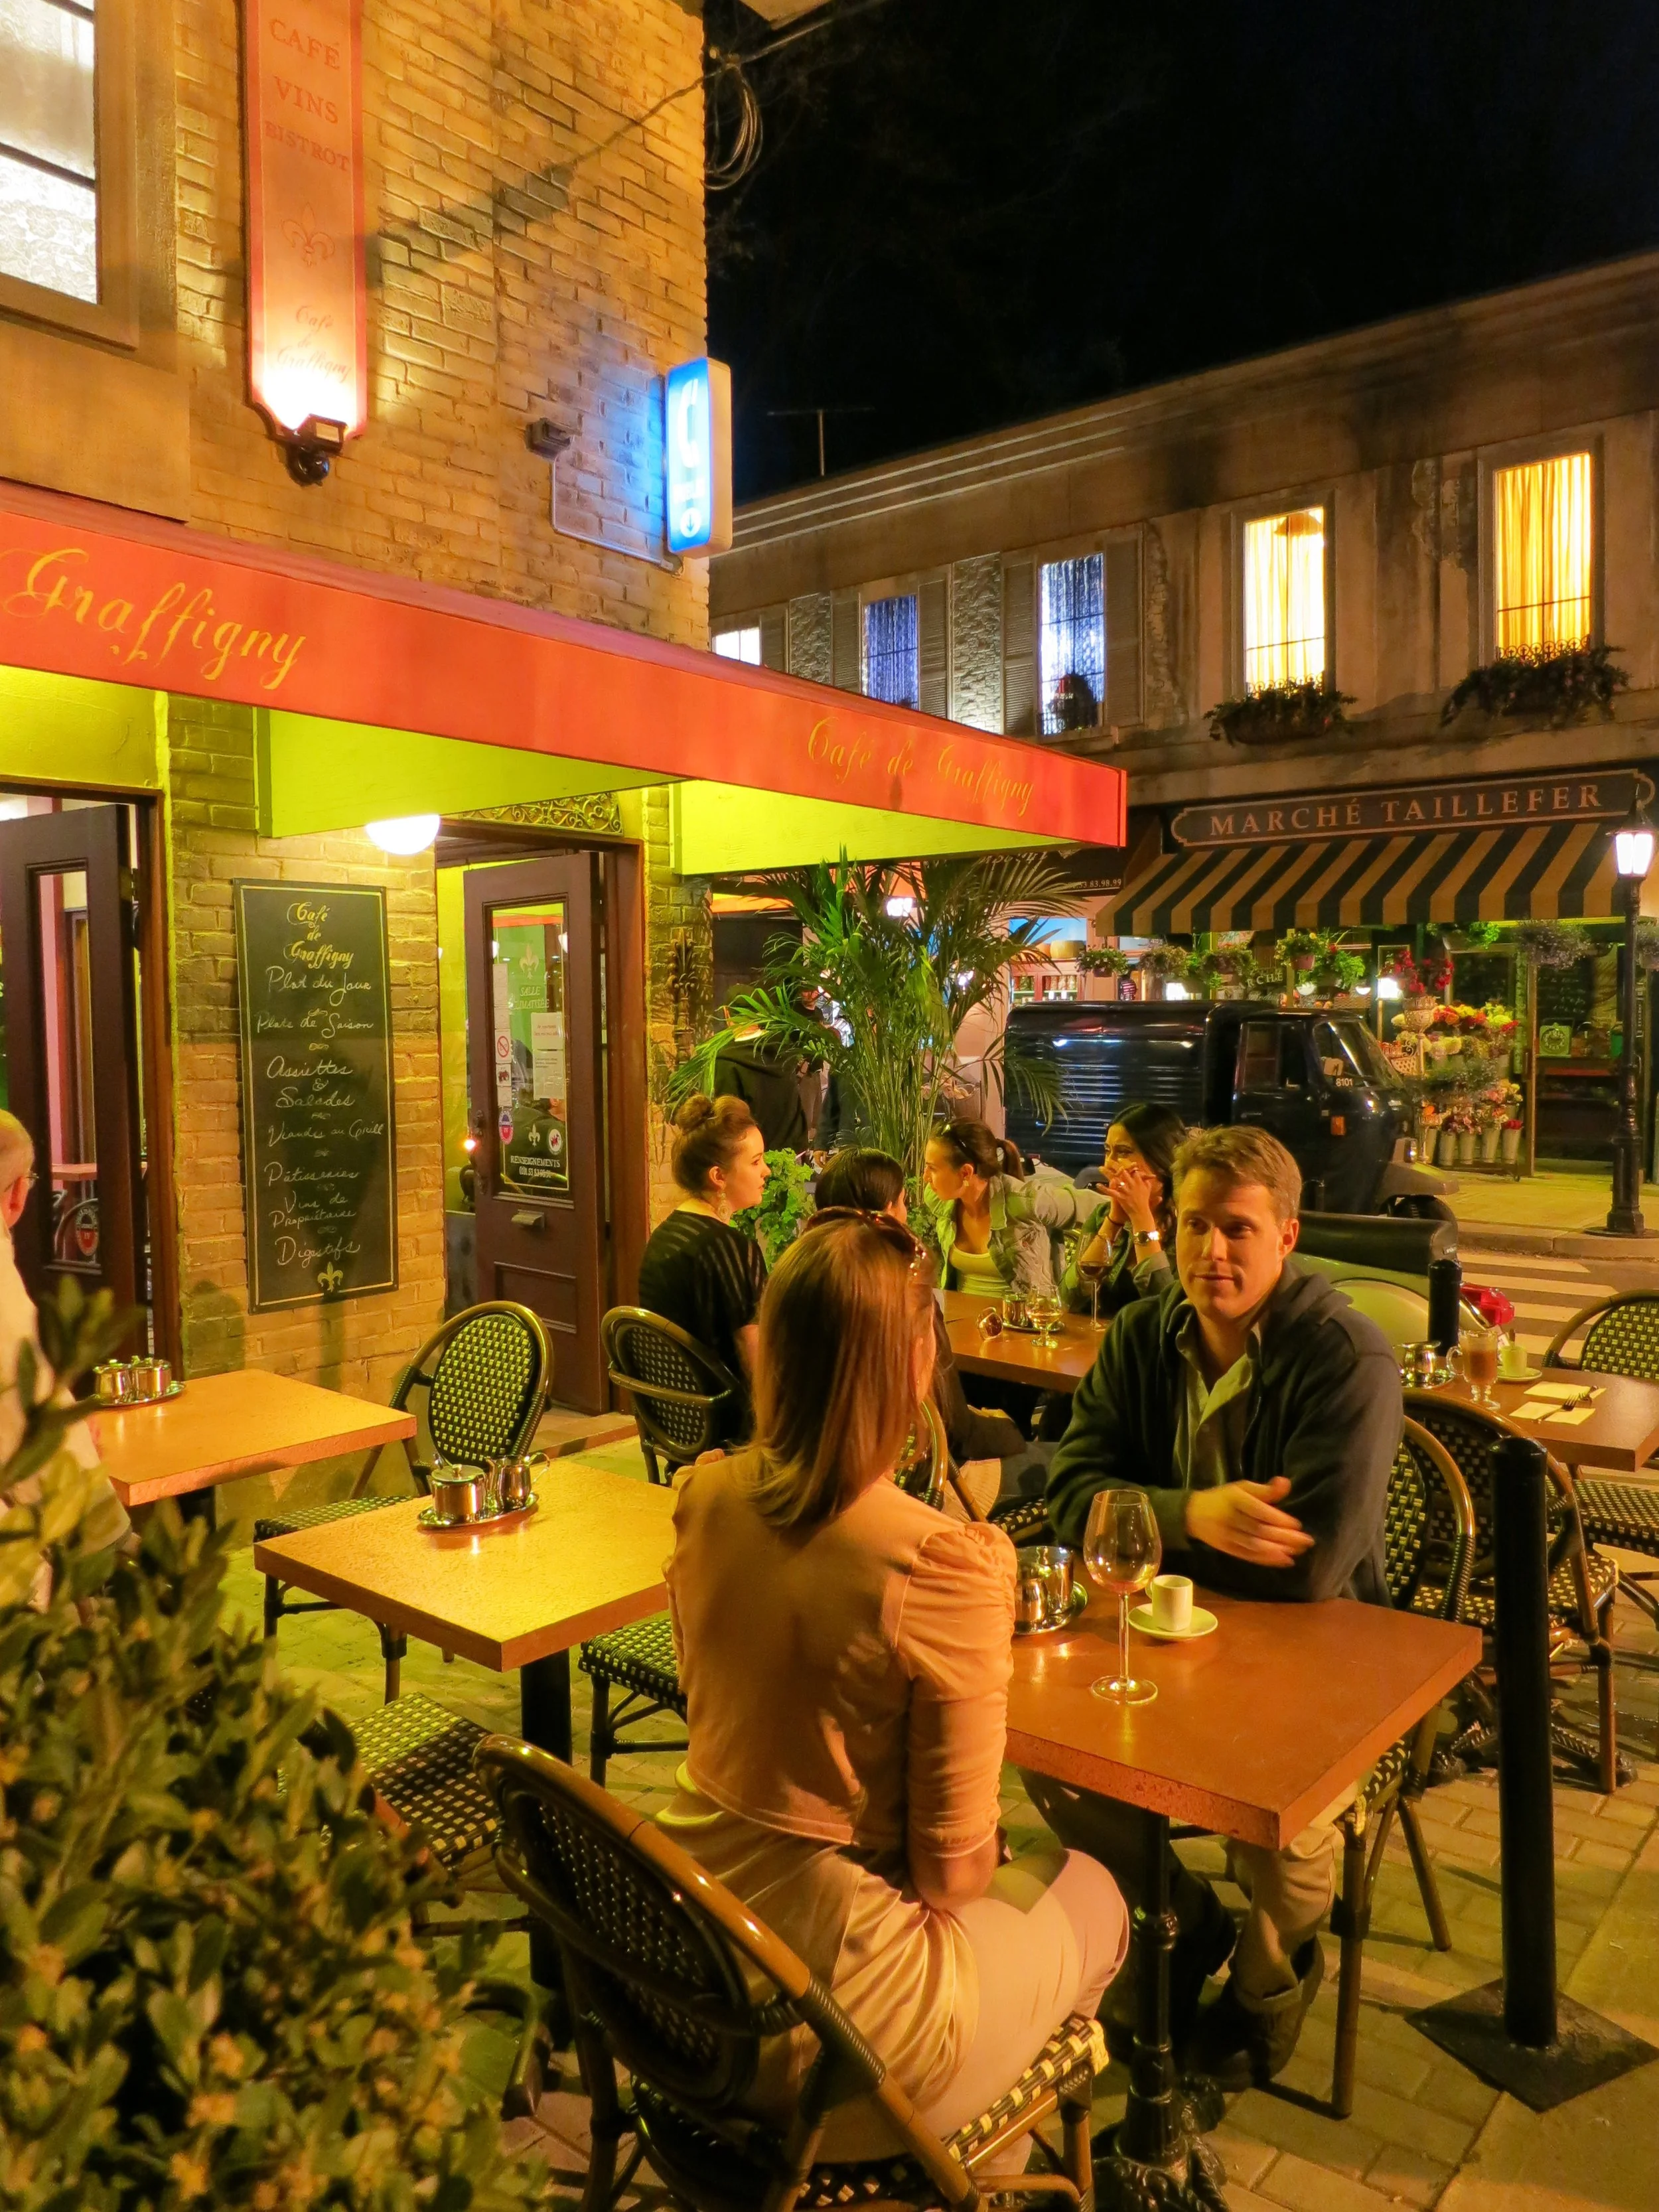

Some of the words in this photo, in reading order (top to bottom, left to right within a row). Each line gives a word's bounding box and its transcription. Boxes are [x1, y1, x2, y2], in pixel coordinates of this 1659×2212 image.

[269, 18, 340, 70] CAFÉ
[274, 76, 338, 125] VINS
[265, 120, 350, 171] BISTROT
[1, 548, 307, 690] Graffigny
[808, 716, 871, 784] Café
[887, 740, 914, 776] de
[936, 744, 1035, 817] Graffigny
[1210, 798, 1360, 836] MARCHÉ
[1381, 784, 1603, 822] TAILLEFER
[287, 902, 330, 928] Café
[307, 925, 321, 940] de
[283, 941, 354, 969] Graffigny
[266, 966, 307, 992] Plat
[313, 974, 333, 988] du
[330, 973, 372, 1006] Jour
[520, 986, 541, 996] SALLE
[300, 1015, 317, 1027] de
[322, 1013, 374, 1038] Saison
[267, 1056, 353, 1078] Assiettes
[1336, 1078, 1353, 1086] 8101
[275, 1086, 356, 1108] Salades
[268, 1122, 326, 1147] Viandes
[349, 1119, 385, 1141] Grill
[510, 1155, 561, 1168] RENSEIGNEMENTS
[284, 1191, 320, 1213] Vins
[329, 1193, 348, 1205] de
[275, 1236, 360, 1268] Digestifs
